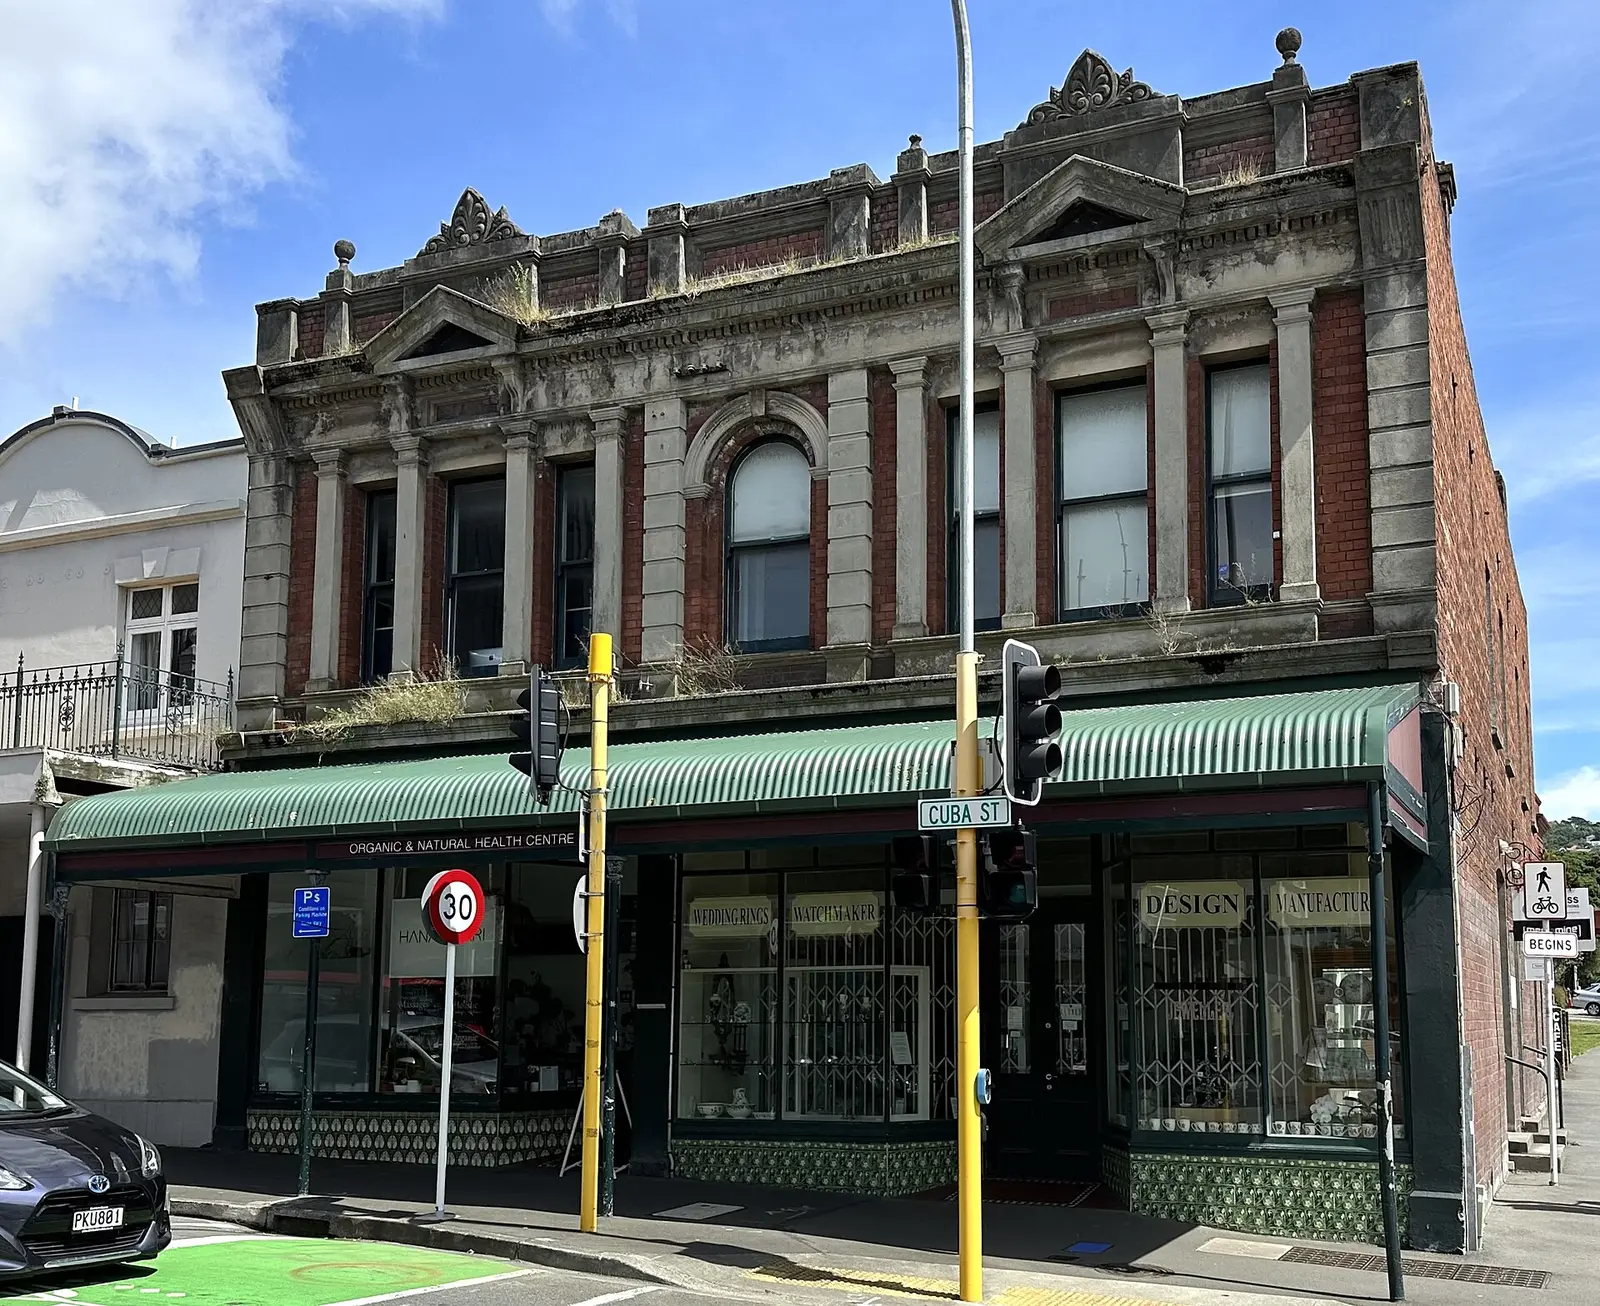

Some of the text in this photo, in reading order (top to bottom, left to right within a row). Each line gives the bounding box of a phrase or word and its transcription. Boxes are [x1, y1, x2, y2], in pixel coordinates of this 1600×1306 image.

[929, 802, 1000, 825] CUBA ST
[349, 833, 575, 855] ORGANIC & NATURAL HEALTH CENTRE
[443, 893, 473, 921] 30
[1146, 894, 1239, 914] DESIGN
[1276, 892, 1370, 913] MANUFACTUR
[694, 907, 769, 925] WEDDING RINGS
[793, 904, 875, 922] WATCHMAKER
[1529, 938, 1572, 951] BEGINS
[1553, 1012, 1562, 1051] CAFE
[74, 1209, 119, 1228] PKU801
